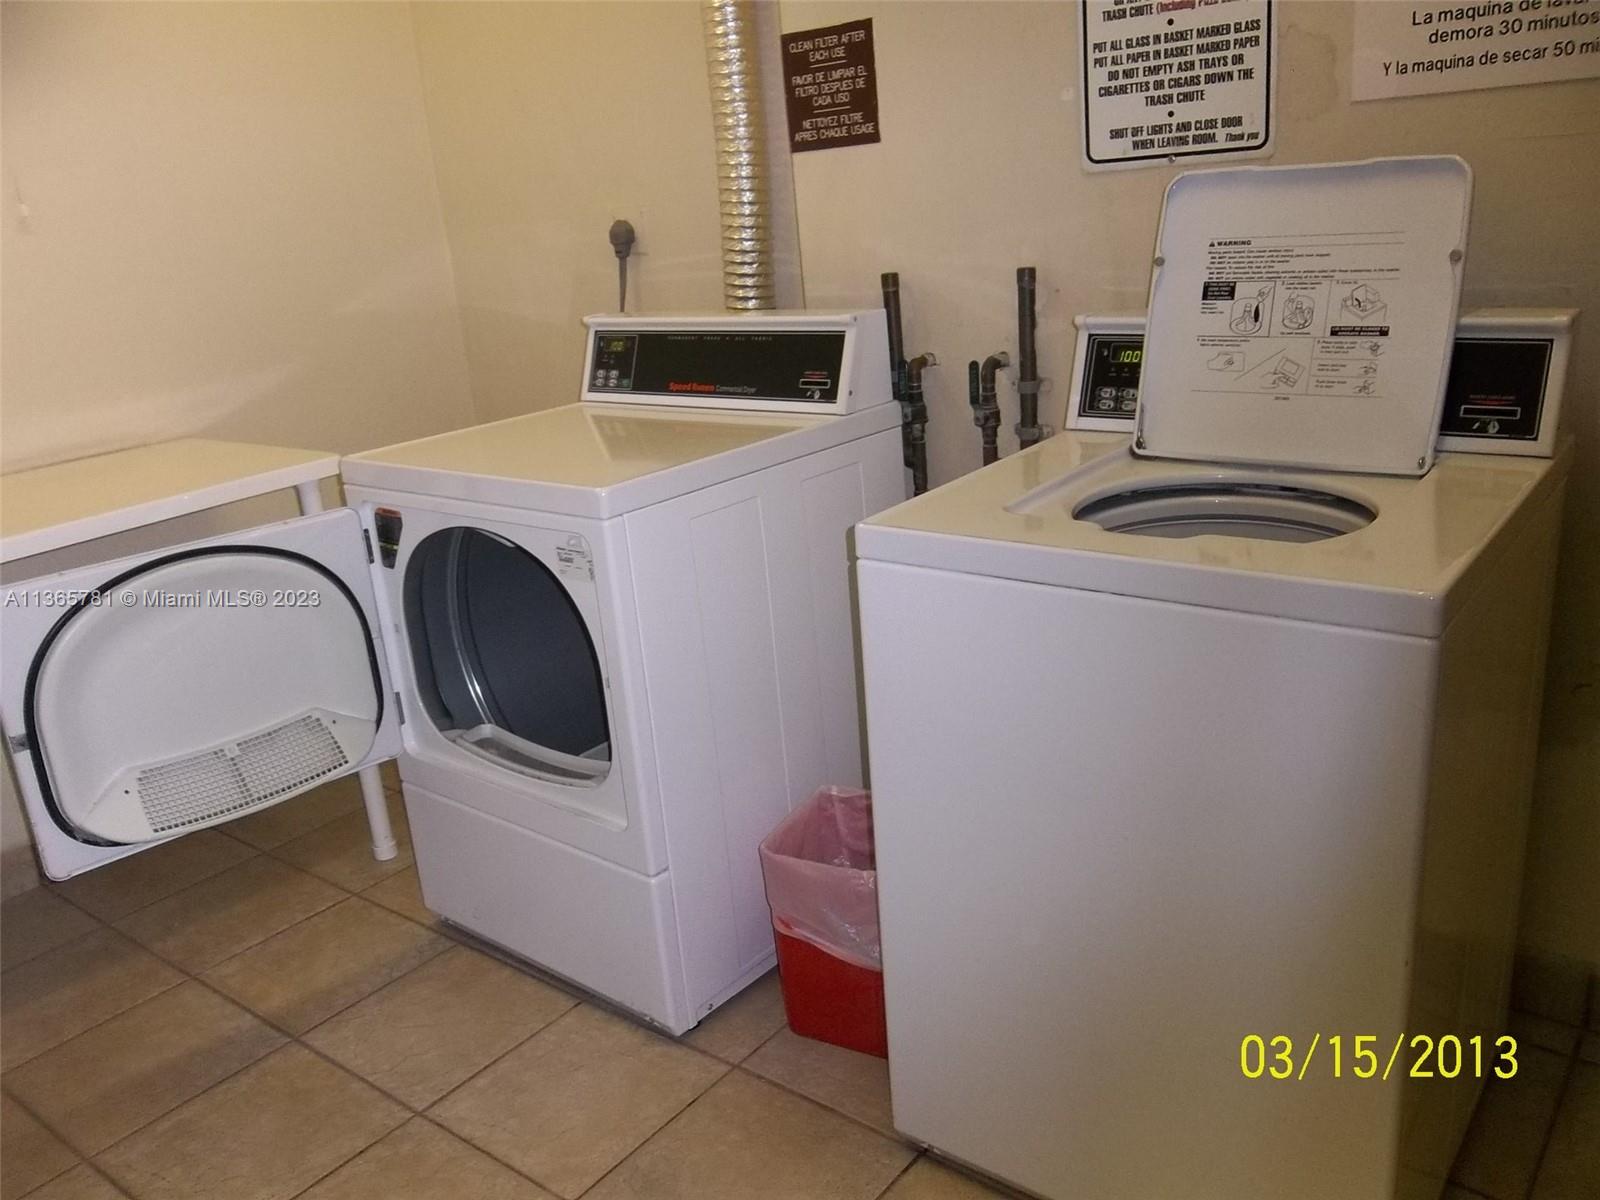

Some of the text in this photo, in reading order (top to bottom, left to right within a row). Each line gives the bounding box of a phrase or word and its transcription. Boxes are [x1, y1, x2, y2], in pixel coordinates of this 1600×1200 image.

[1102, 10, 1127, 22] TRASH
[1129, 4, 1153, 18] CHUTE
[1412, 11, 1433, 26] La
[1438, 0, 1513, 22] maquina
[1519, 0, 1542, 11] de
[1092, 19, 1262, 54] PUT ALL GLASS IN BASKET MARKED GLASS
[1429, 11, 1600, 44] demora 30 minutos
[789, 30, 866, 53] CLEAN FILTER AFTER
[809, 46, 846, 62] EACH USE
[1093, 35, 1261, 69] PUT ALL PAPER IN BASKET MARKED PAPER
[1383, 62, 1392, 76] Y
[1396, 61, 1408, 75] la
[1412, 54, 1475, 74] maquina
[1479, 50, 1498, 66] de
[1503, 47, 1549, 63] secar
[1553, 40, 1575, 57] 50
[791, 65, 868, 86] FAVOR DE LIMPIAR EL
[1107, 53, 1244, 82] DO NOT EMPTY ASH TRAYS OR
[795, 78, 867, 98] FILTRO DESPUES DE
[1098, 67, 1254, 98] CIGARETTES OR CIGARS DOWN THE
[812, 92, 850, 107] CADA USO
[1144, 90, 1206, 107] TRASH CHUTE
[802, 112, 864, 129] NETTOYEZ FILTRE
[1109, 116, 1243, 140] SHUT OFF LIGHTS AND CLOSE DOOR
[795, 122, 876, 142] APRES CHAQUE USAGE
[1132, 132, 1218, 151] WHEN LEAVING ROOM.
[1225, 131, 1260, 143] Thank you
[1120, 350, 1142, 362] 100
